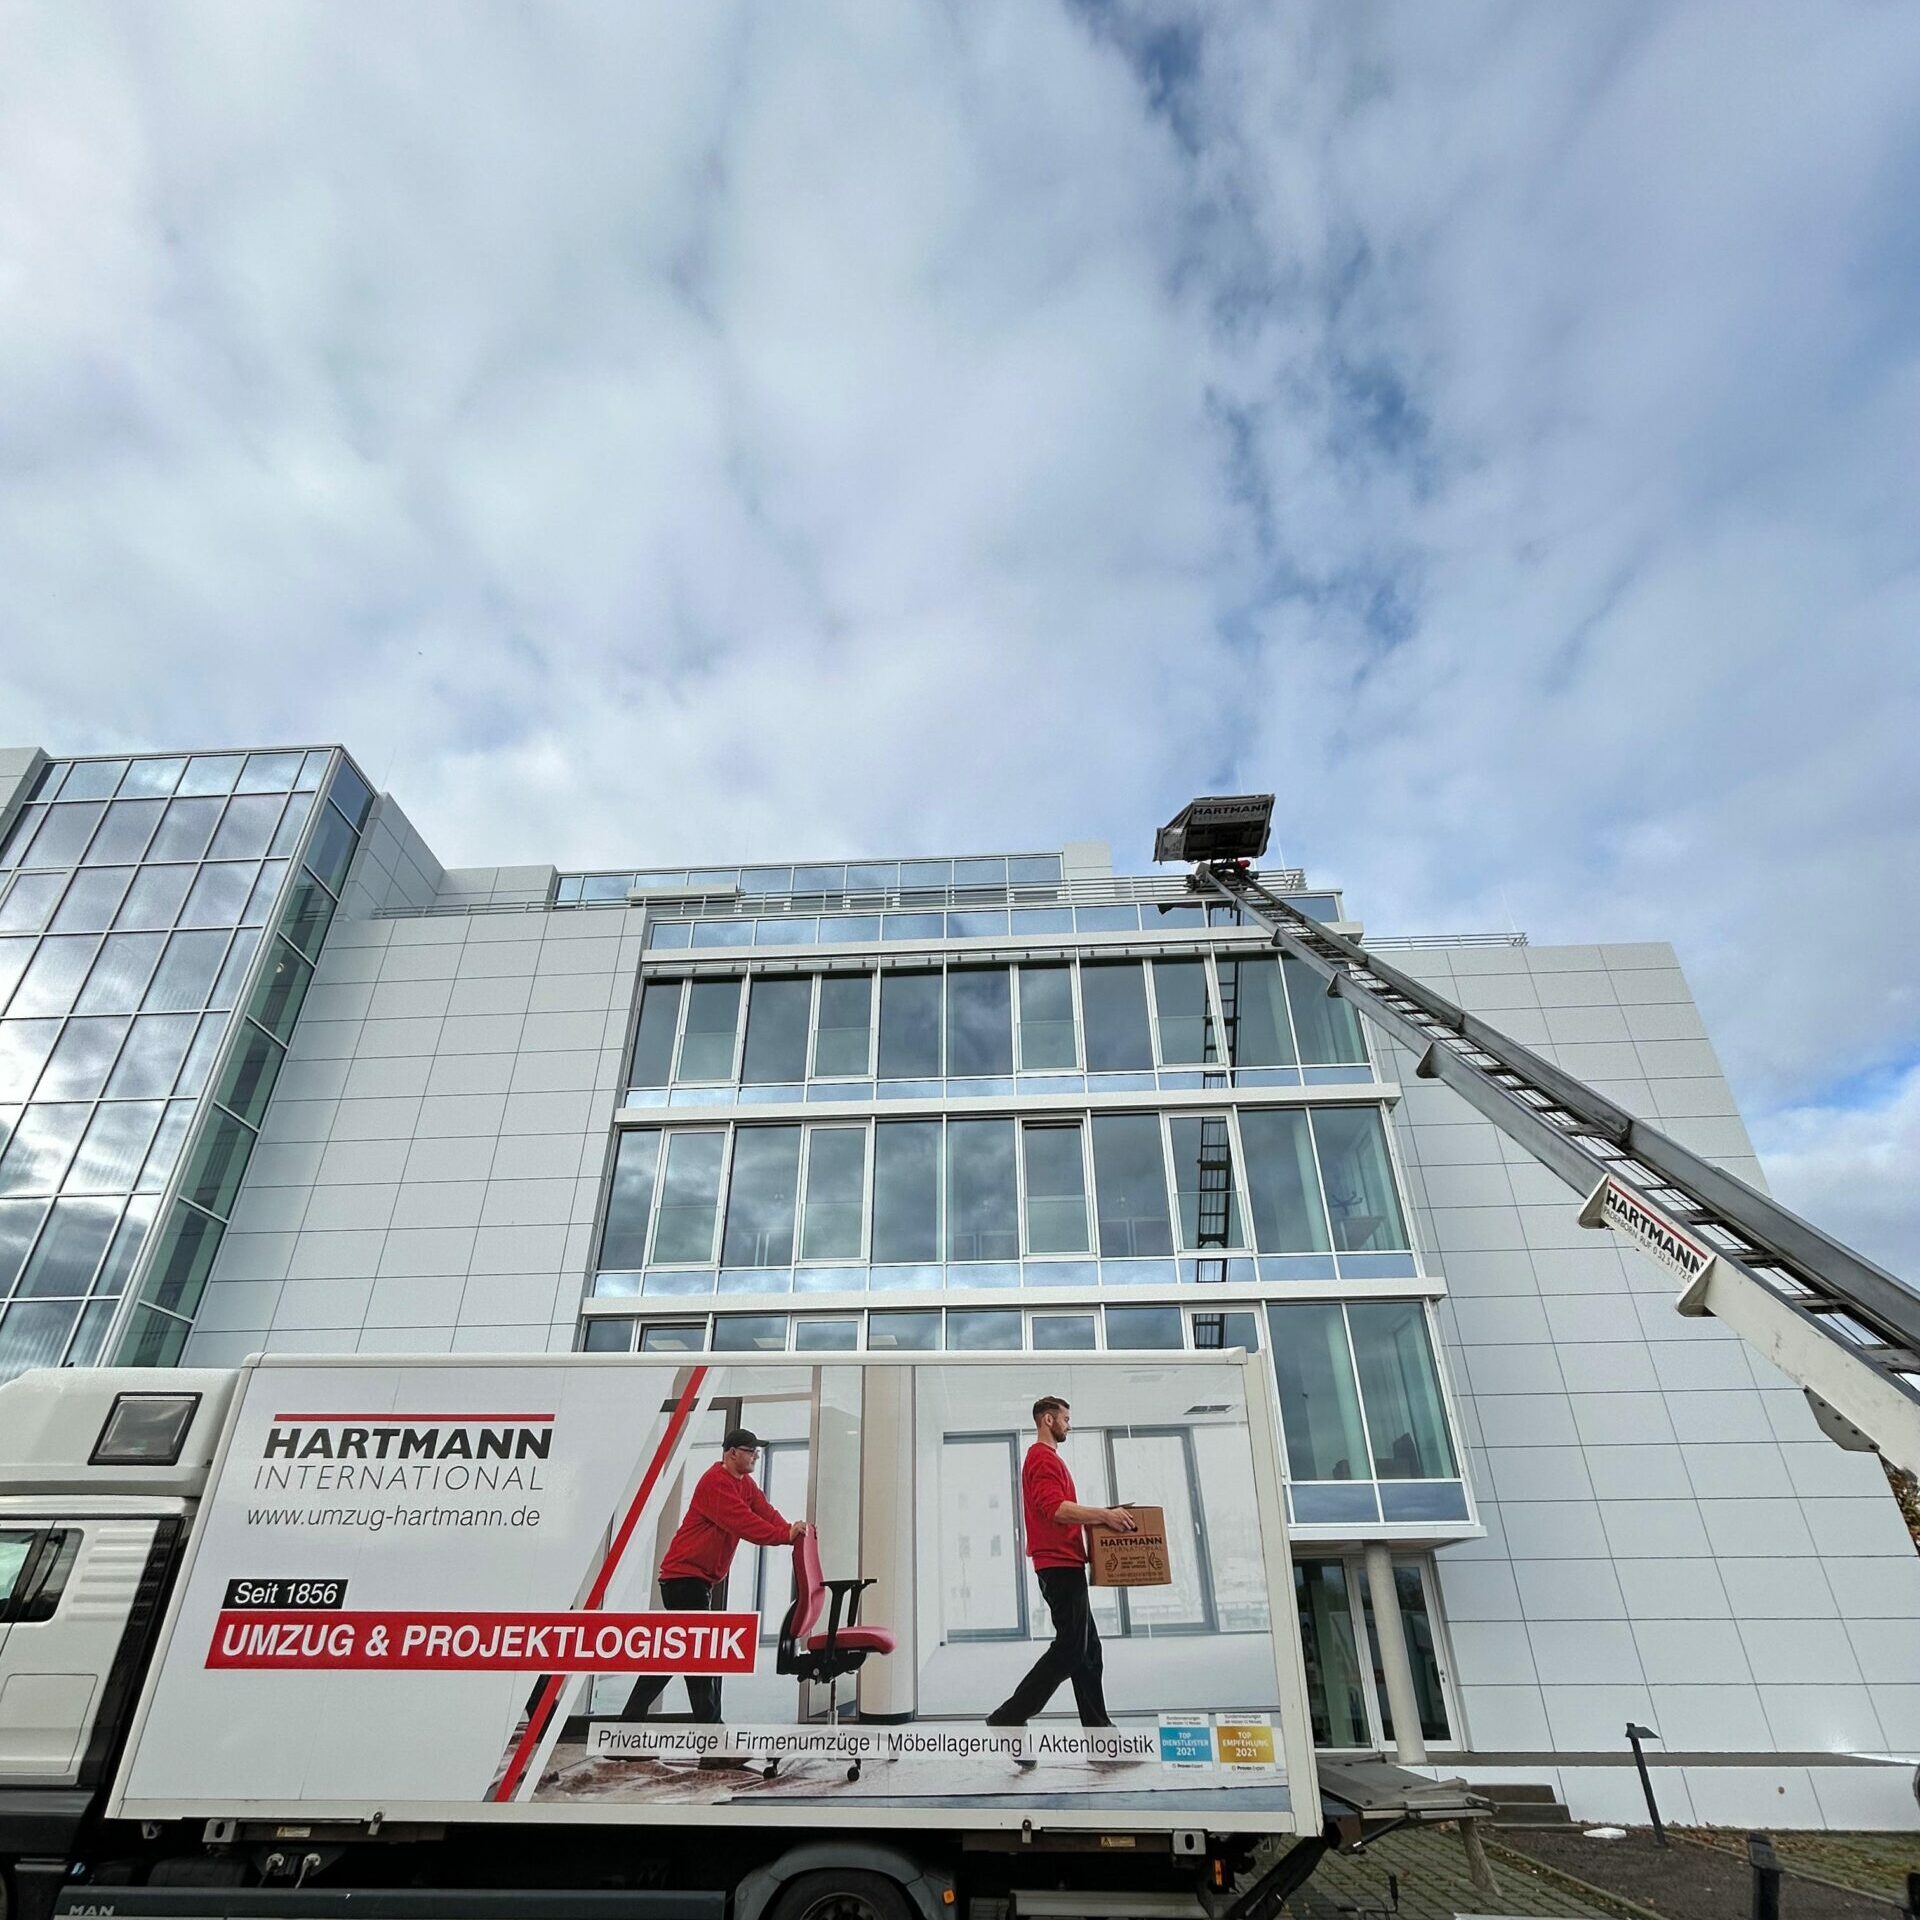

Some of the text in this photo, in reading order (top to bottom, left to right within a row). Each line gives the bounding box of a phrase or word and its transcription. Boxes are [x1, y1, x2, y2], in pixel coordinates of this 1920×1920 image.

[1606, 1189, 1704, 1274] HARTMANN
[263, 1428, 553, 1459] HARTMANN
[254, 1465, 544, 1490] INTERNATIONAL
[247, 1505, 541, 1532] www.umzug-hartmann.de
[1100, 1537, 1163, 1547] HARTMANN
[234, 1582, 338, 1604] Seit 1856
[222, 1624, 747, 1660] UMZUG & PROJEKTLOGISTIK
[1162, 1739, 1209, 1747] DIENSTLEISTER
[1222, 1739, 1269, 1747] EMPFEHLUNG
[1238, 1731, 1251, 1739] TOP
[598, 1730, 718, 1753] Privatumzüge
[736, 1731, 870, 1755] Firmenumzüge
[888, 1733, 1022, 1757] Möbellagerung
[1039, 1734, 1155, 1758] Aktenlogistik
[1176, 1747, 1196, 1756] 2021
[1235, 1748, 1257, 1757] 2021
[70, 1905, 114, 1916] MAN
